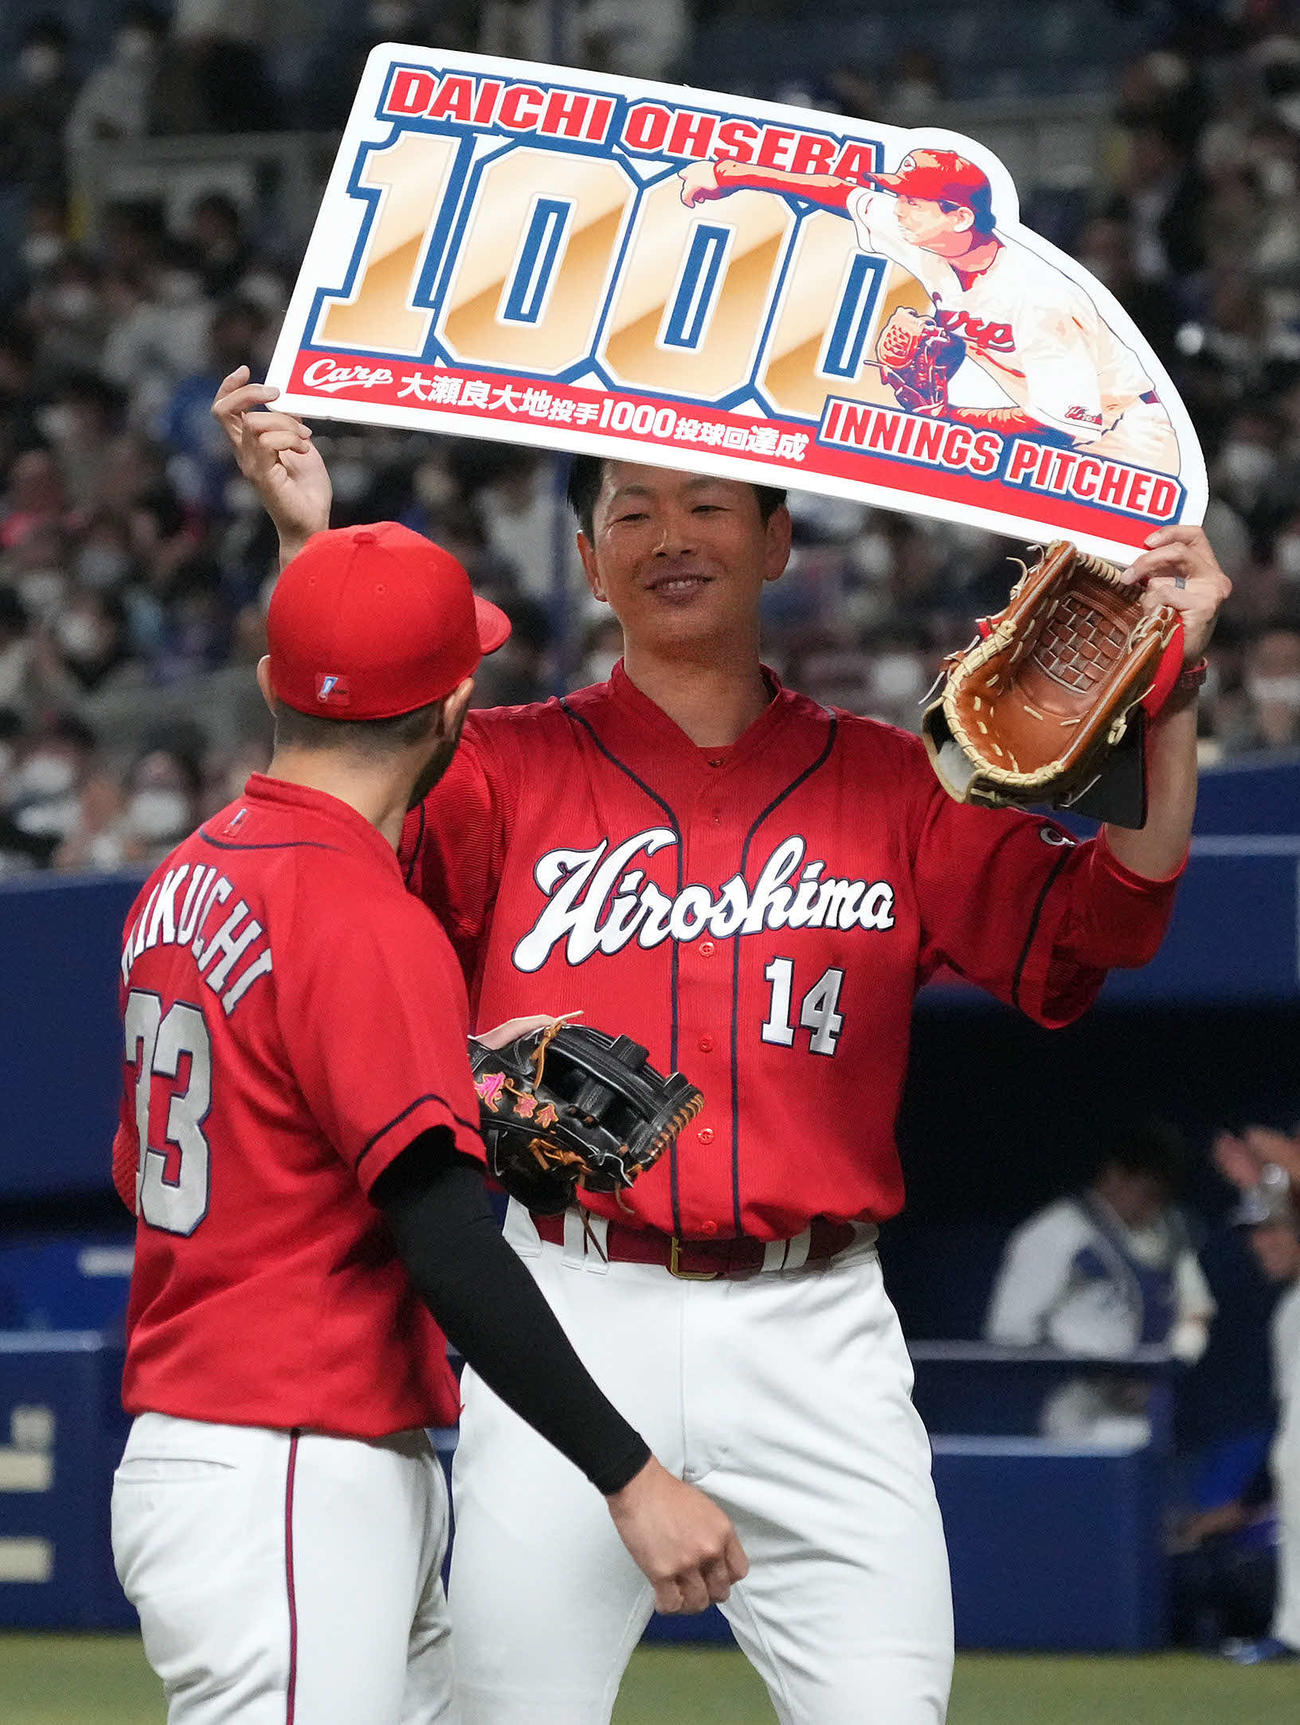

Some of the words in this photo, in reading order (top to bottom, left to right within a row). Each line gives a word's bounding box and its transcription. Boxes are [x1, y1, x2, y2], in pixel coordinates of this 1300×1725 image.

[385, 69, 612, 142] DAICHI
[623, 104, 876, 188] OHSERA
[312, 129, 934, 416] 1000
[302, 358, 394, 393] Carp
[397, 371, 810, 462] 大瀬良大地投手1000投球回達成
[822, 401, 1000, 474] INNINGS
[1006, 442, 1179, 522] PITCHED
[512, 827, 896, 973] Hiroshima
[760, 956, 845, 1057] 14
[124, 988, 212, 1238] 33
